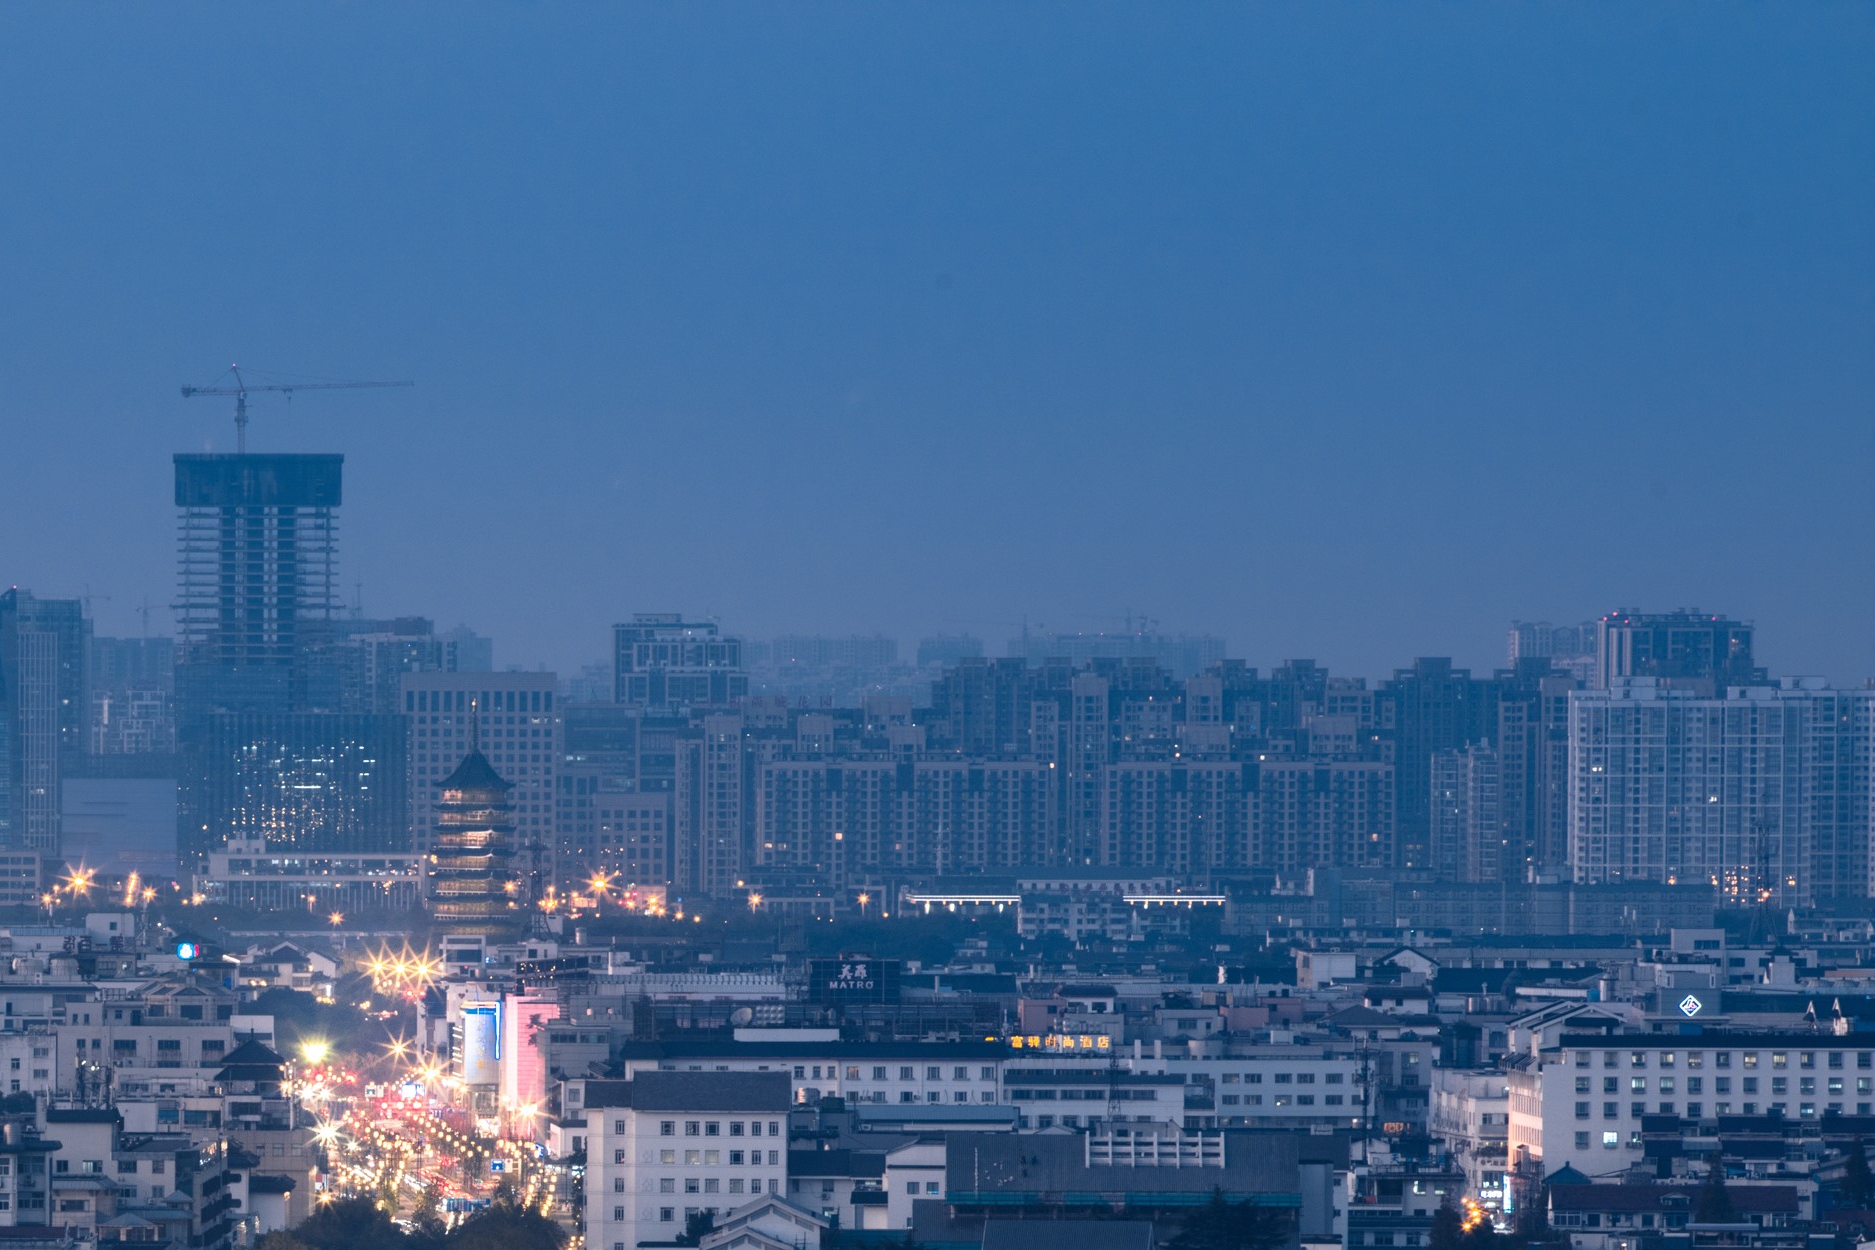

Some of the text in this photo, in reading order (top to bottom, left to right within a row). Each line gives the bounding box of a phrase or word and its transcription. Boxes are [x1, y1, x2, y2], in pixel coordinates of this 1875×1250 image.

[829, 981, 874, 990] MATRO
[1010, 1035, 1110, 1048] 富驿时尚酒店
